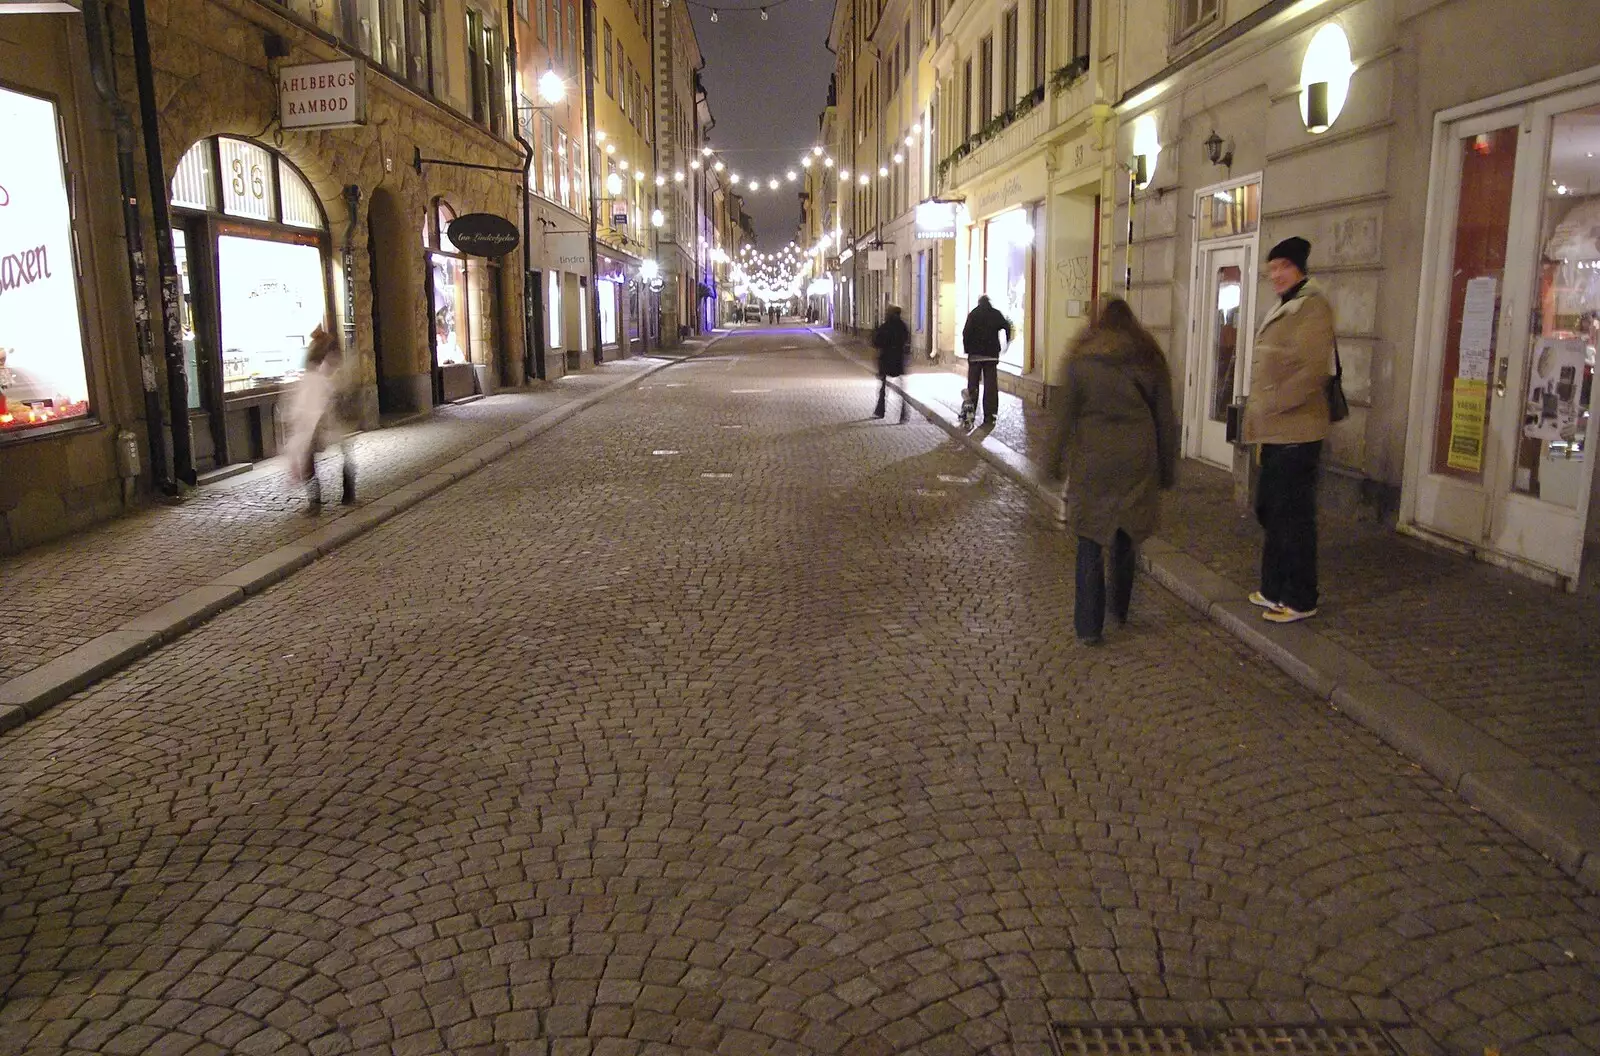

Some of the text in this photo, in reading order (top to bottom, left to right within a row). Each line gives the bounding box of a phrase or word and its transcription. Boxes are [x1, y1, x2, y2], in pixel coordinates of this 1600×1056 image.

[281, 72, 355, 93] AHLBERGS
[288, 97, 348, 116] RAMBOD
[232, 158, 264, 200] 36
[559, 255, 585, 264] tindra
